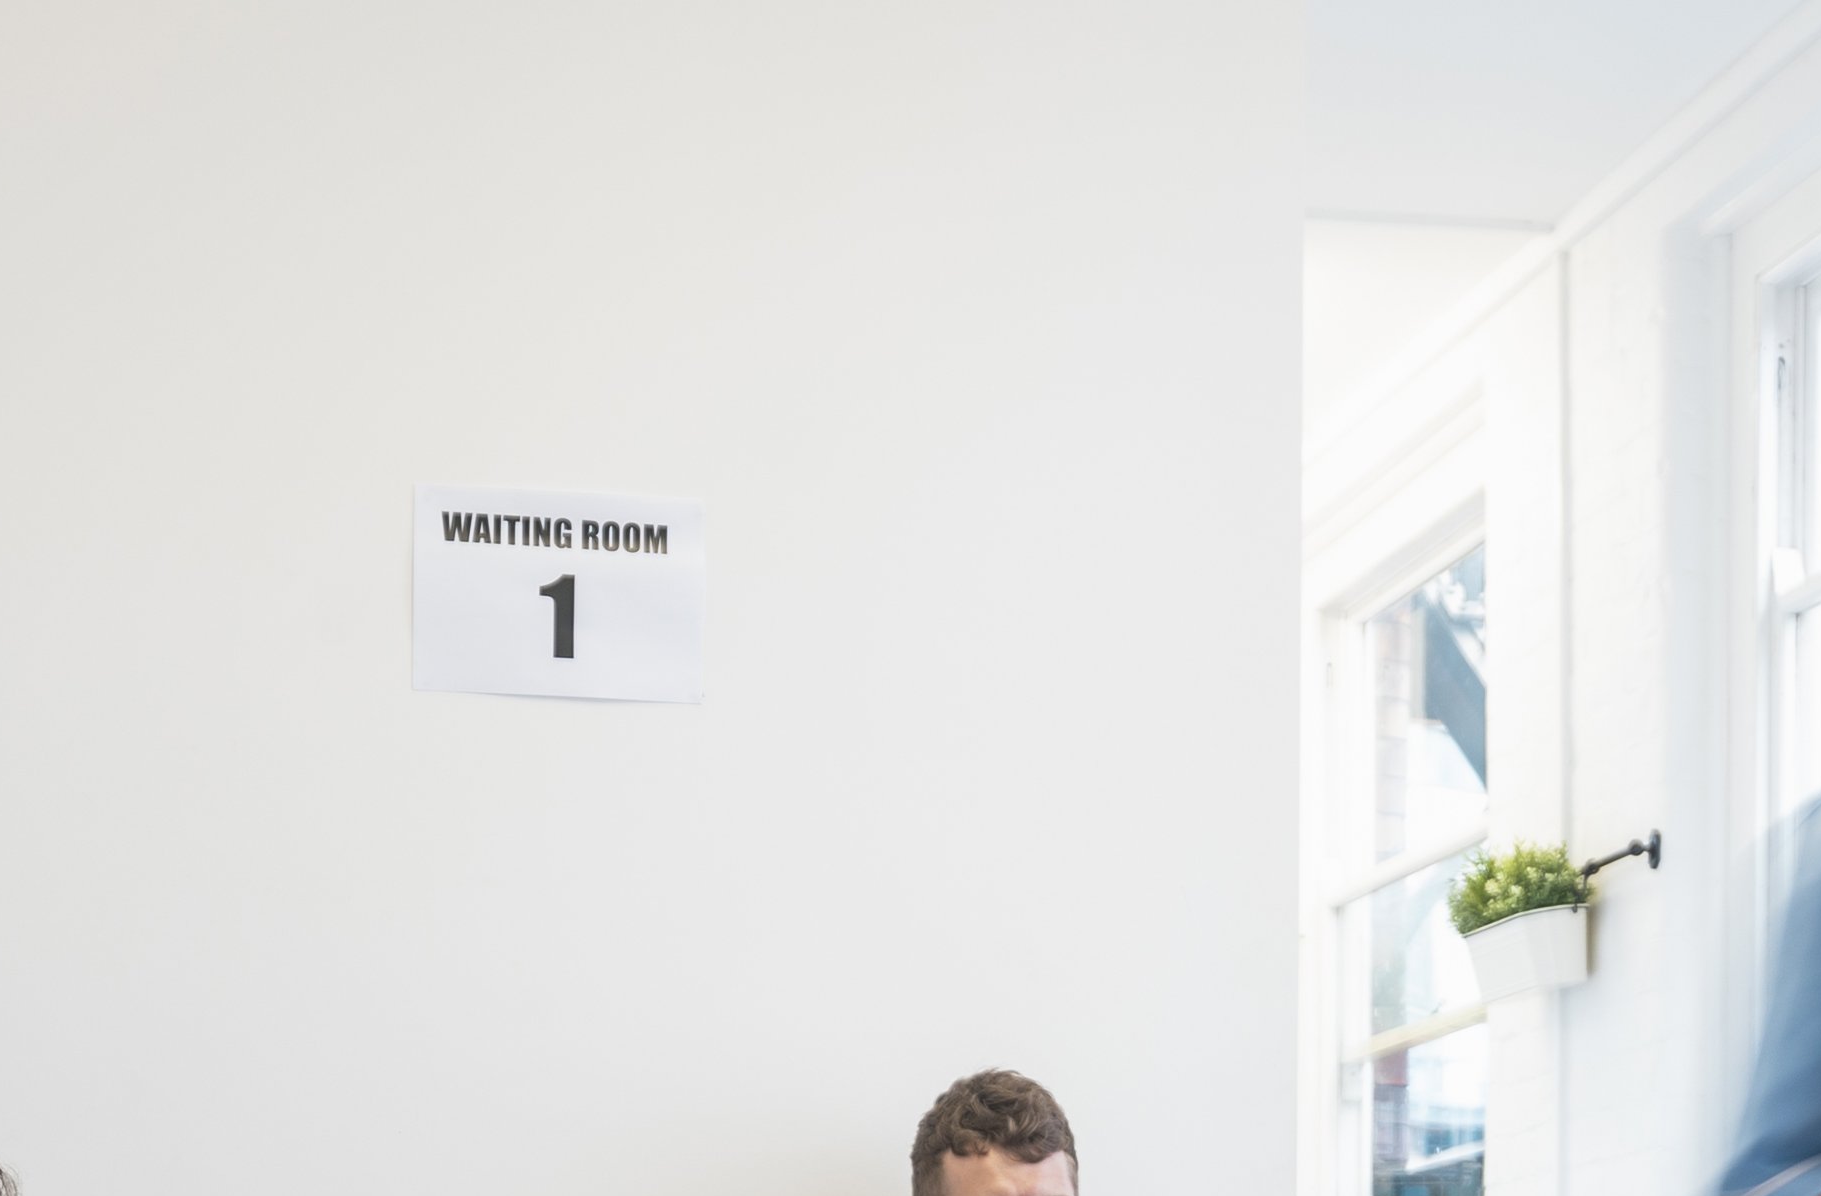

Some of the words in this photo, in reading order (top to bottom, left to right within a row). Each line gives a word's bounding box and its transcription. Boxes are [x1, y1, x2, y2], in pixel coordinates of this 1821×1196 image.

[441, 511, 573, 549] WAITING
[581, 519, 668, 555] ROOM
[539, 573, 576, 659] 1
